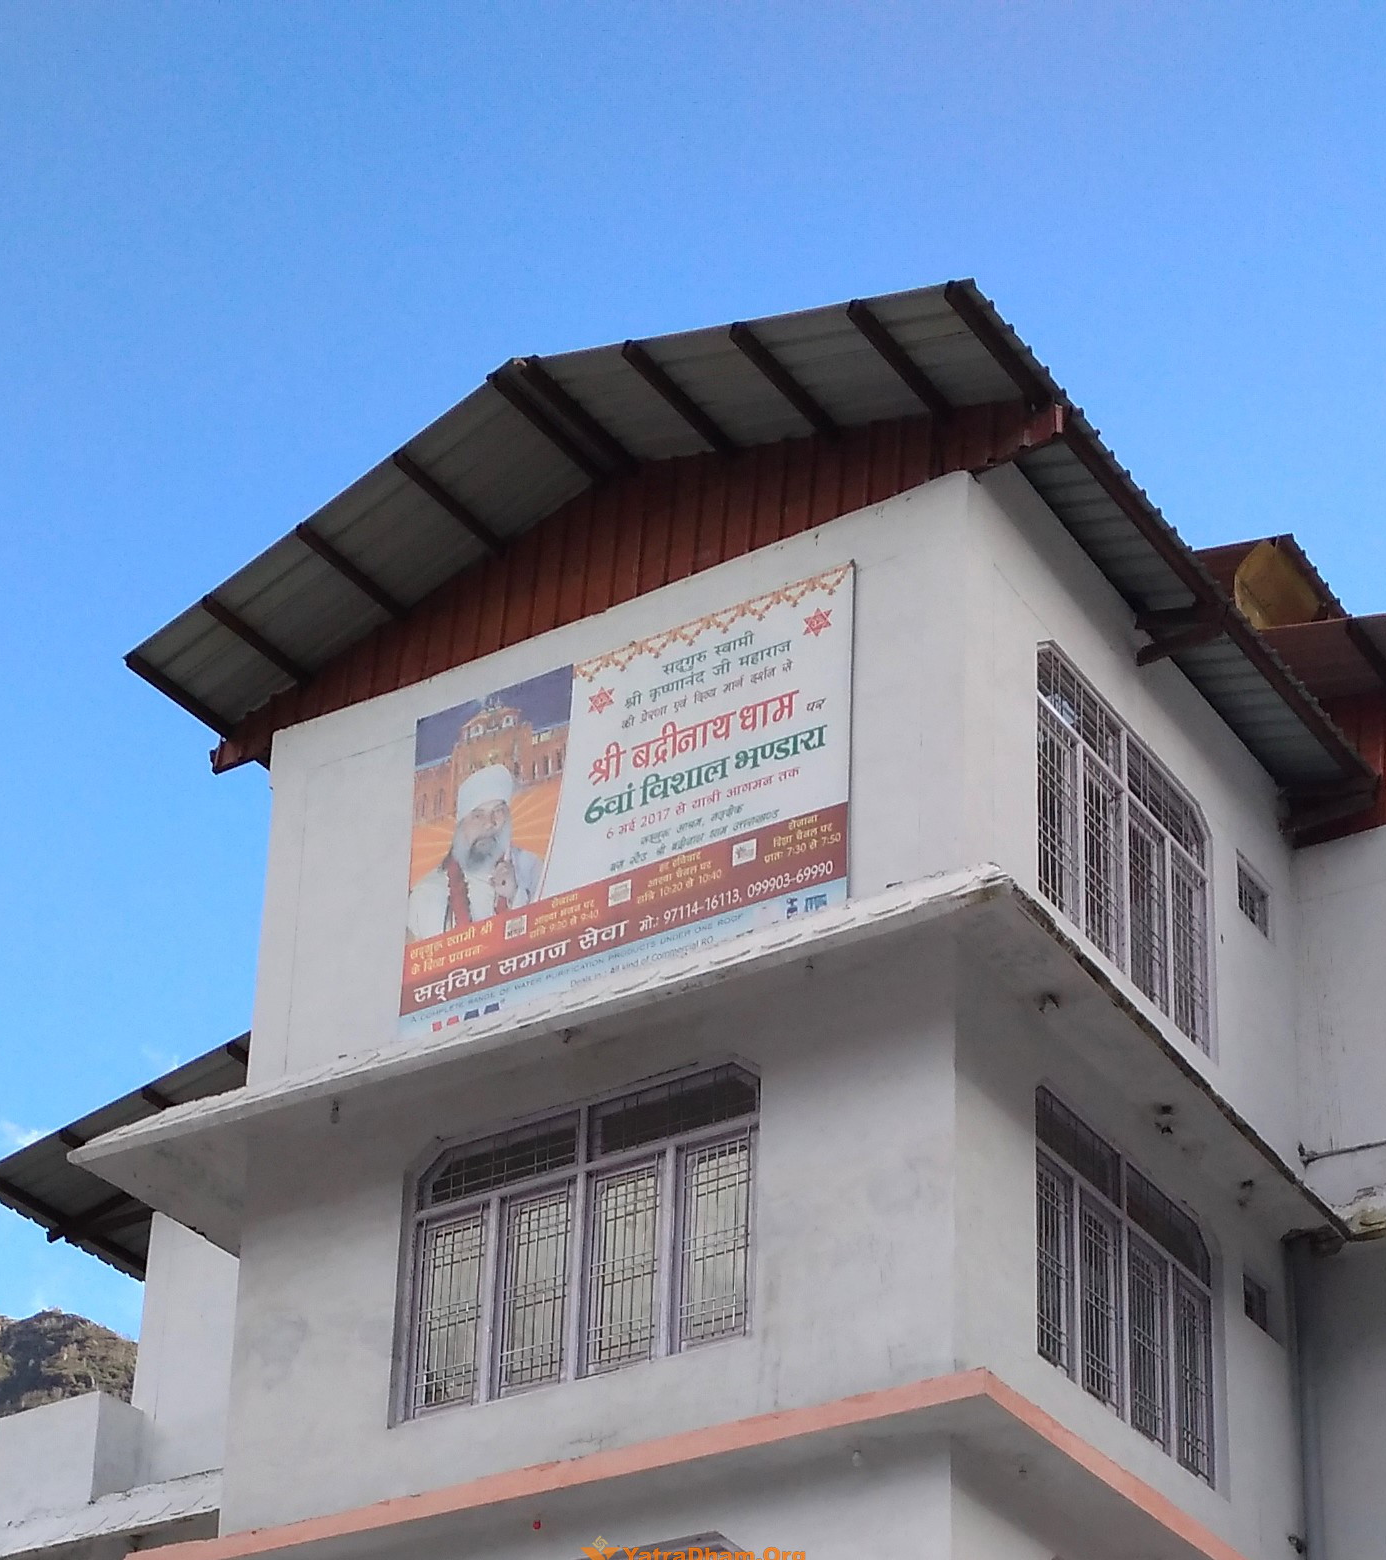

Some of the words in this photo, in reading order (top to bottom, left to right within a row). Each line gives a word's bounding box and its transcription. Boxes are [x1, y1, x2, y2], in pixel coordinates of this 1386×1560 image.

[624, 690, 641, 709] श्री
[649, 670, 705, 702] कृष्णानंद
[712, 660, 730, 677] जी
[738, 640, 792, 667] महाराज
[662, 650, 707, 675] सद्गुरु
[714, 631, 754, 656] स्वामी
[588, 741, 626, 786] श्री
[631, 711, 737, 769] बद्रीनाथ
[739, 689, 800, 732] धाम
[805, 697, 827, 713] पर
[584, 783, 634, 824] 6वां
[639, 755, 730, 807] विशाल
[734, 724, 828, 770] भण्डारा
[606, 827, 614, 840] 6
[618, 818, 636, 836] मई
[641, 808, 670, 830] 2017
[675, 802, 686, 817] से
[726, 774, 774, 799] आगमन
[778, 766, 801, 782] तक
[821, 832, 841, 847] 7:50
[698, 869, 722, 884] 10:40
[497, 939, 571, 975] समाज
[578, 920, 630, 951] सेवा
[663, 889, 742, 925] 97114-16113,
[747, 860, 834, 898] 099903-69990
[694, 923, 713, 935] ONE
